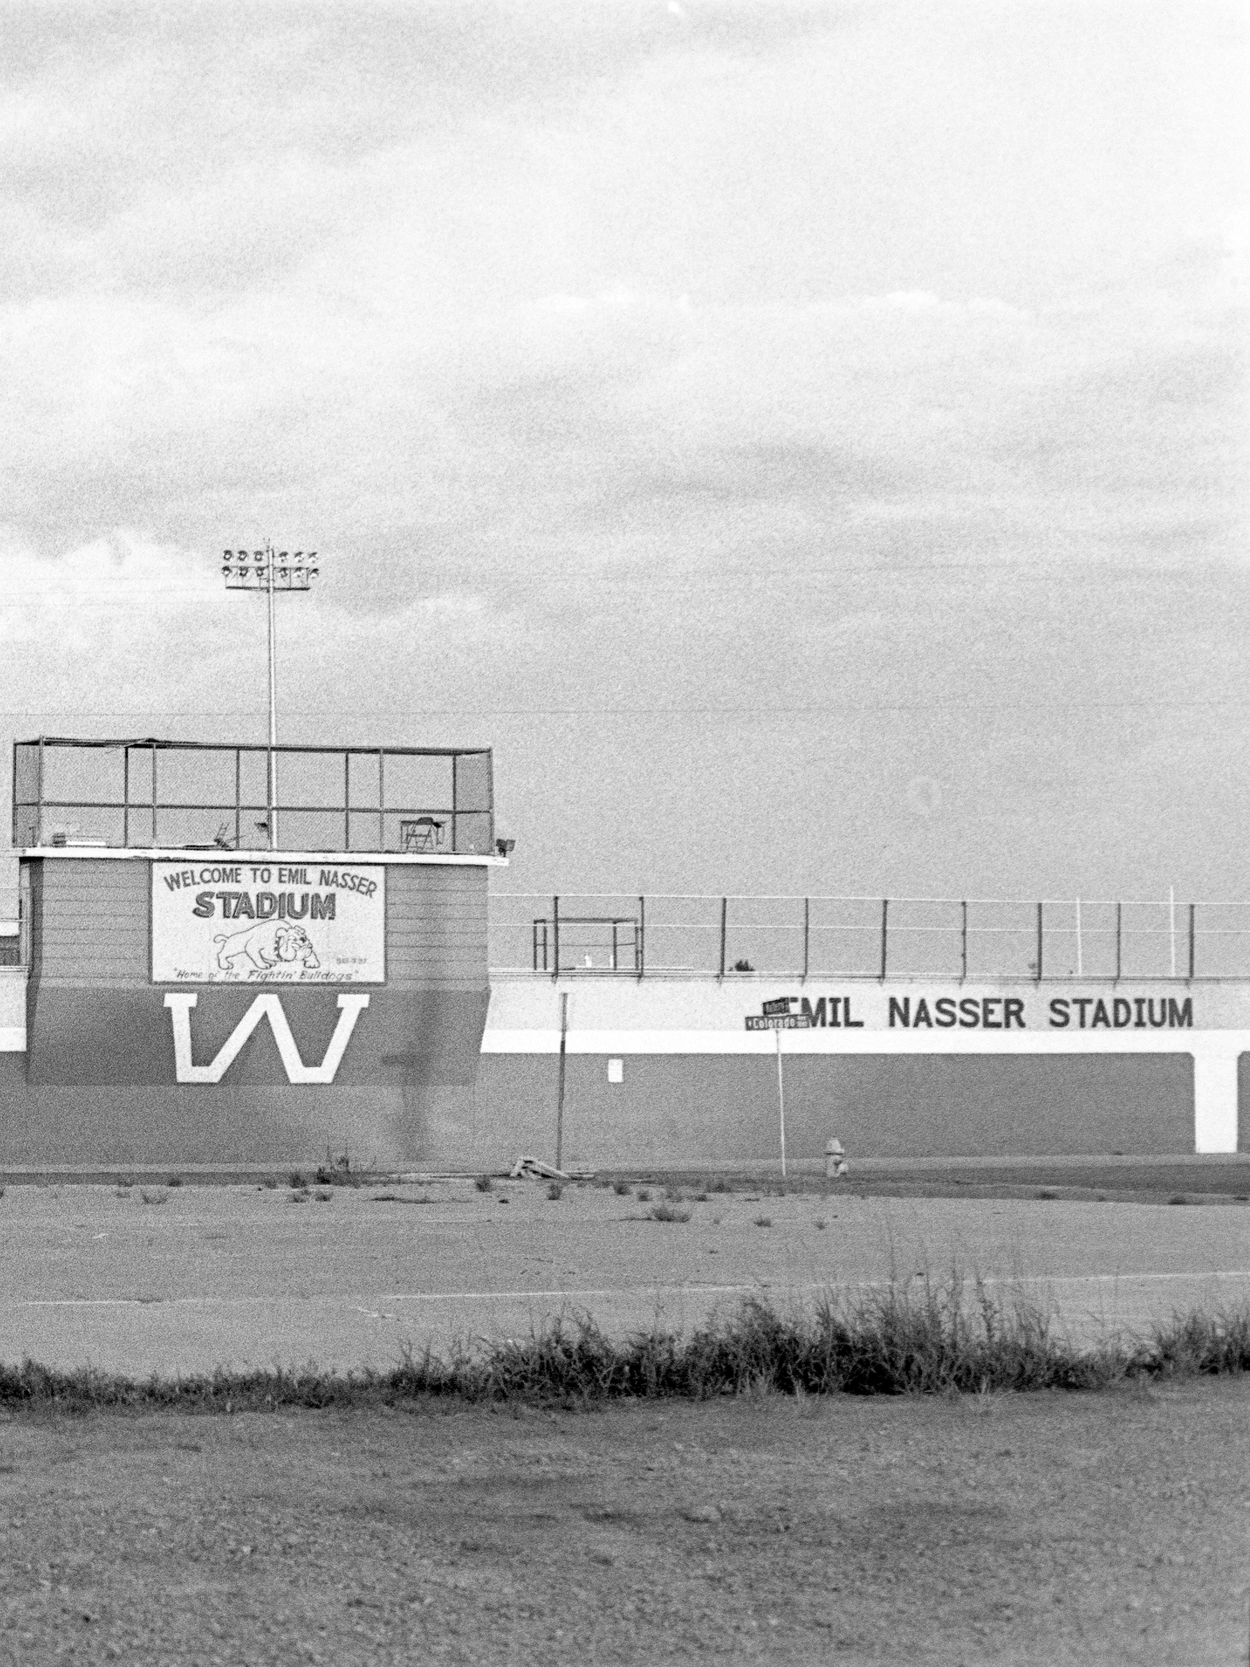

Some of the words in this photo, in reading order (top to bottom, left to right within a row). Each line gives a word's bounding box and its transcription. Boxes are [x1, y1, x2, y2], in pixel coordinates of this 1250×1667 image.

[163, 867, 242, 891] WELCOME
[250, 867, 271, 884] TO
[278, 867, 312, 885] EMIL
[319, 869, 377, 898] NASSER
[192, 891, 336, 920] STADIUM
[753, 1016, 796, 1029] Colorado
[780, 996, 865, 1028] MIL
[888, 997, 1026, 1028] NASSER
[1049, 998, 1193, 1028] STADIUM
[163, 993, 370, 1084] W
